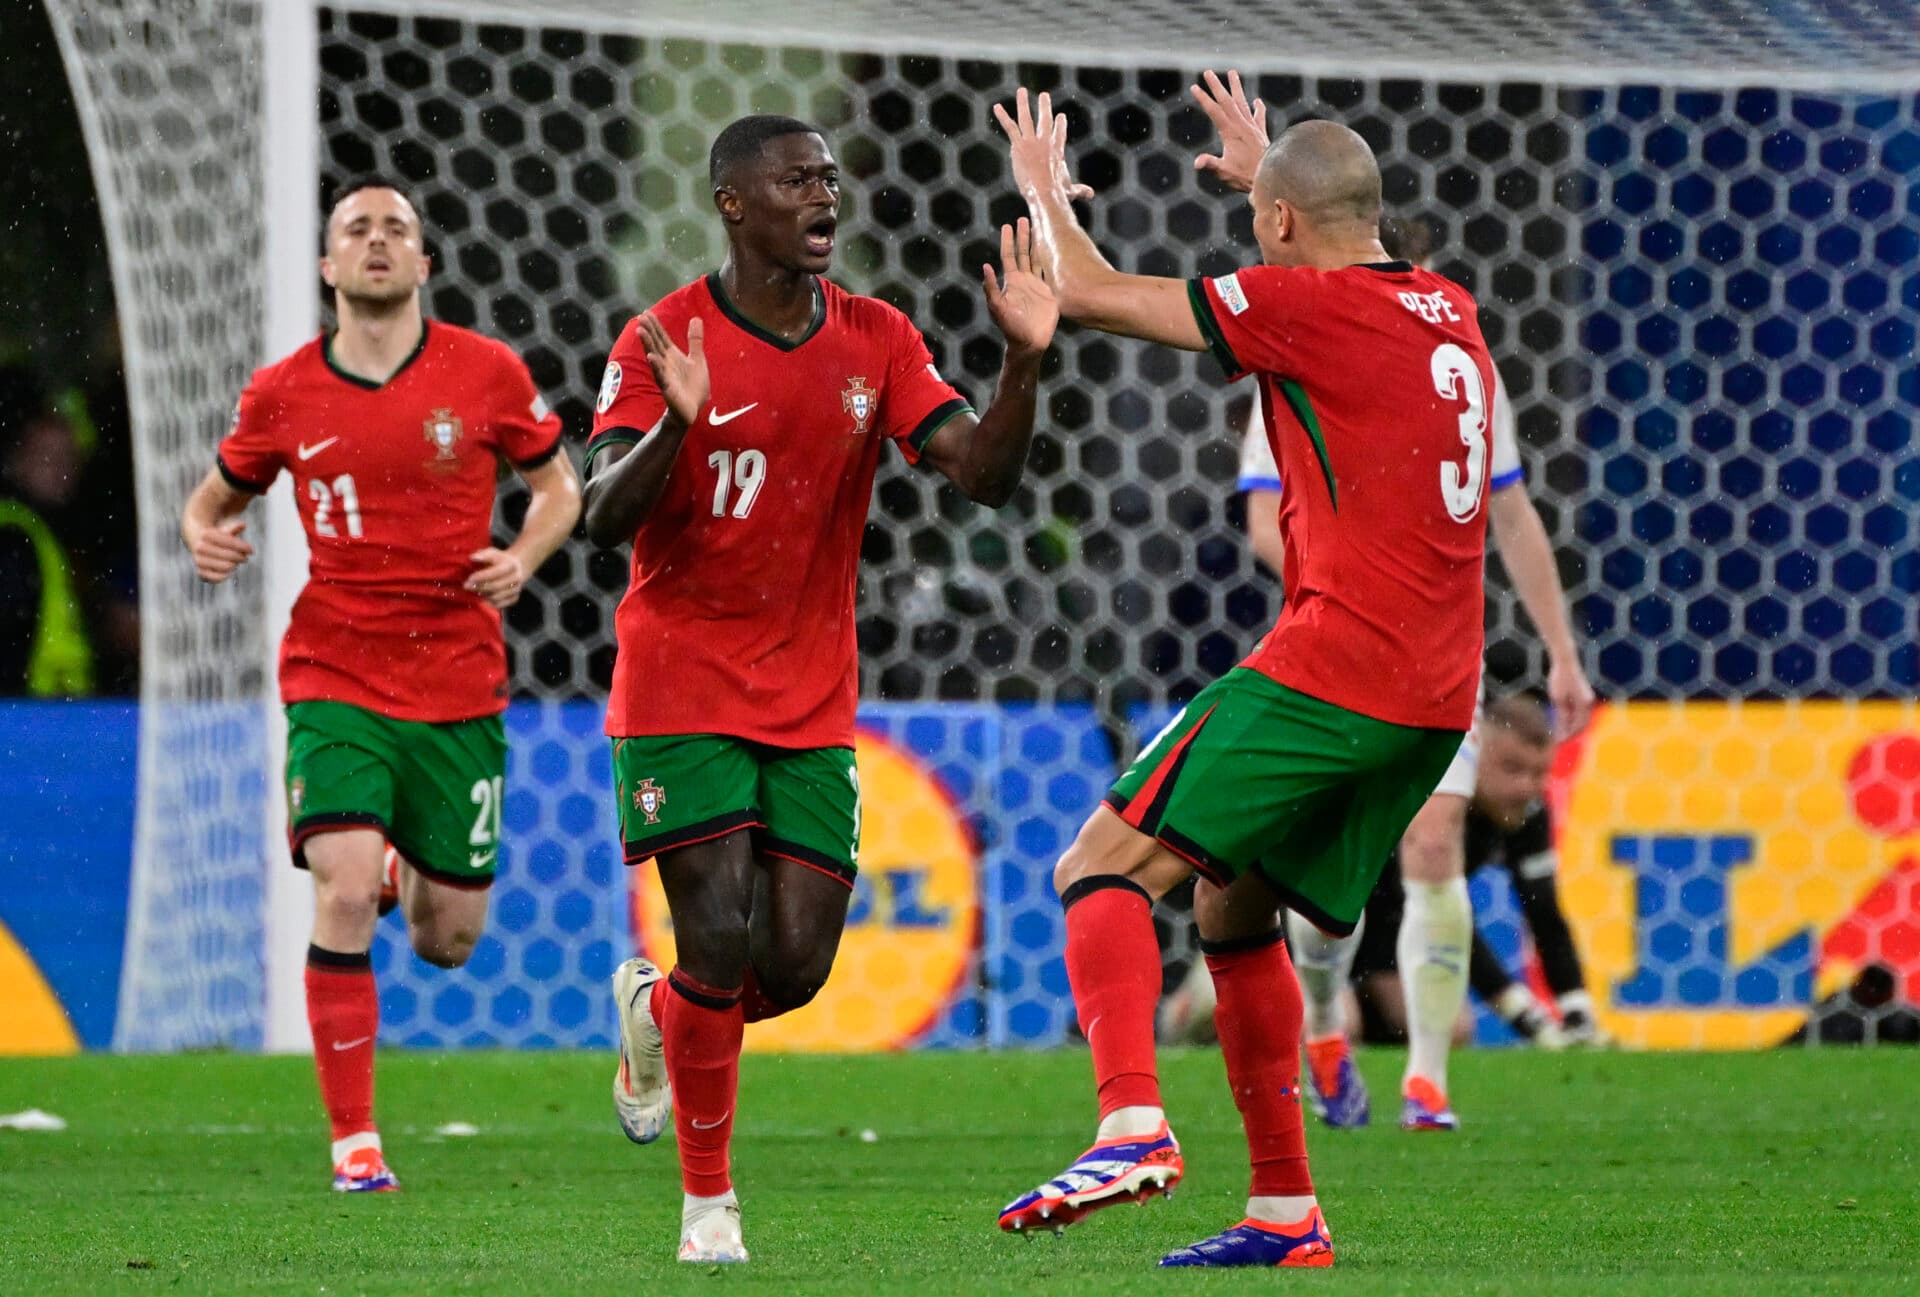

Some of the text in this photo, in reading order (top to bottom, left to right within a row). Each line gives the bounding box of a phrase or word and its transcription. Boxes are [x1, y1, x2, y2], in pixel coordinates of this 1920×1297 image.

[1397, 290, 1461, 324] PEPE
[1430, 343, 1487, 524] 3
[309, 473, 364, 538] 21
[708, 449, 767, 519] 19
[469, 775, 504, 846] 21
